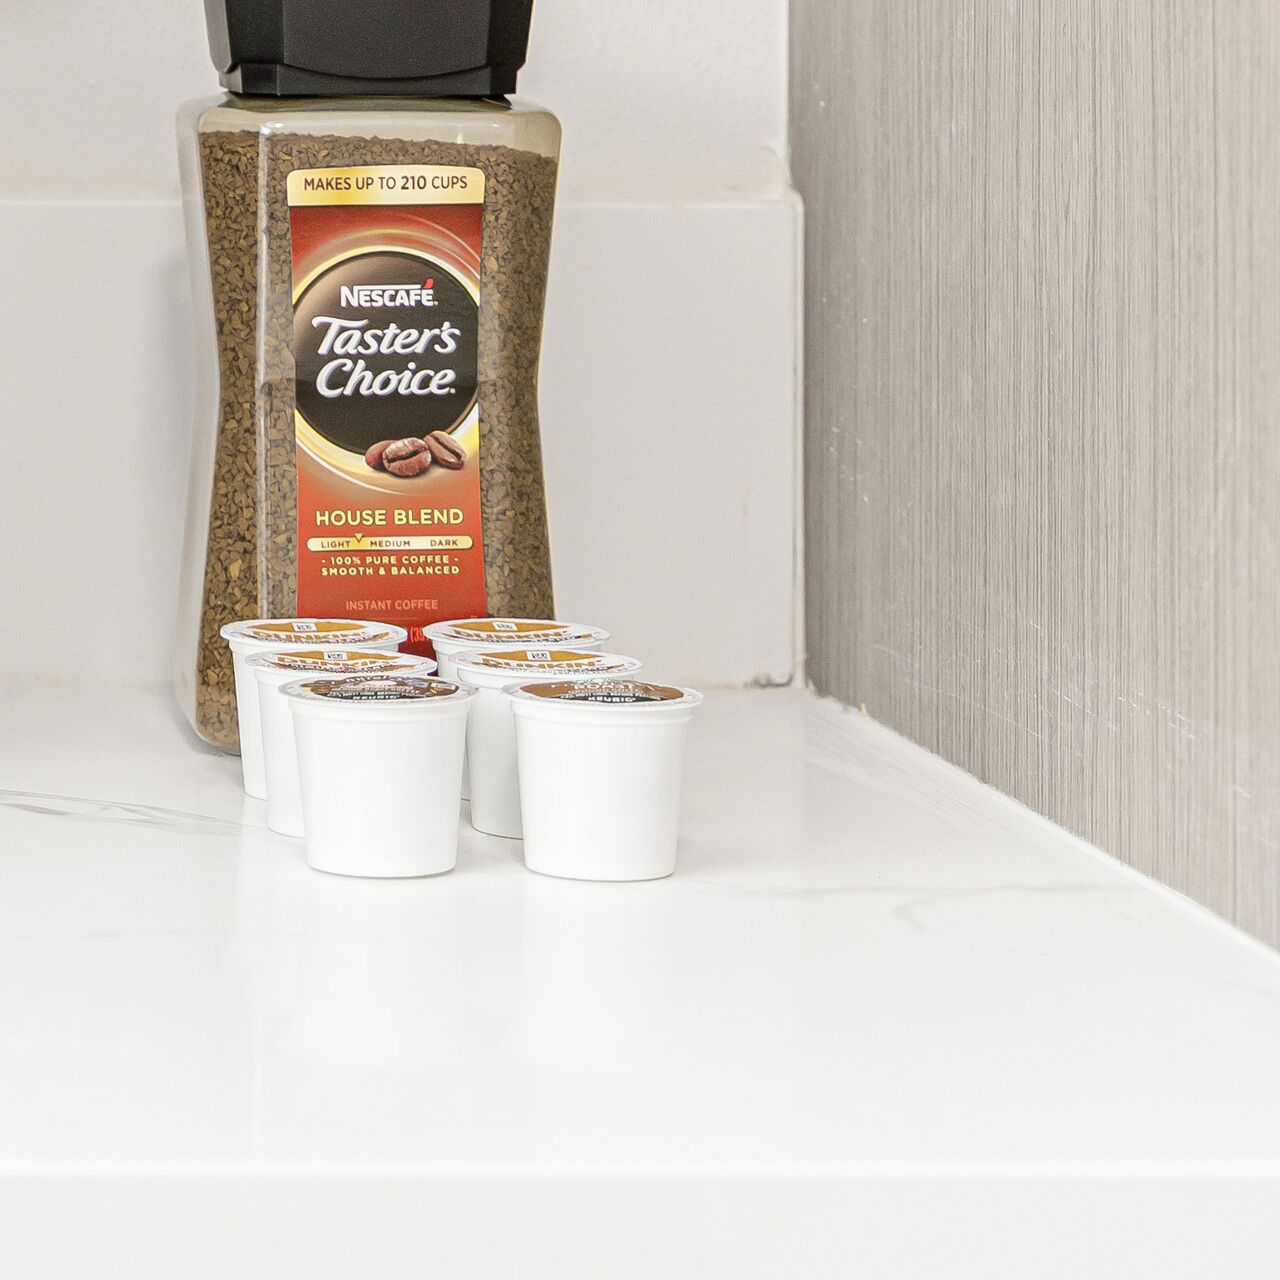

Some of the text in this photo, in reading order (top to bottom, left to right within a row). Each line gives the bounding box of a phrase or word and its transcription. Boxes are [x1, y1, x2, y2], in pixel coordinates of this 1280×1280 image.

[303, 175, 468, 191] MAKES UP TO 210 CUPS
[311, 315, 461, 356] Taster's
[316, 358, 456, 398] Choice
[315, 507, 465, 527] HOUSE BLEND
[321, 539, 458, 548] LIGHT MEDIUM DARK
[330, 555, 450, 565] 100% PURE COFFEE
[321, 566, 460, 576] SMOOTH & BALANCED
[346, 599, 439, 611] INSTANT COFFEE
